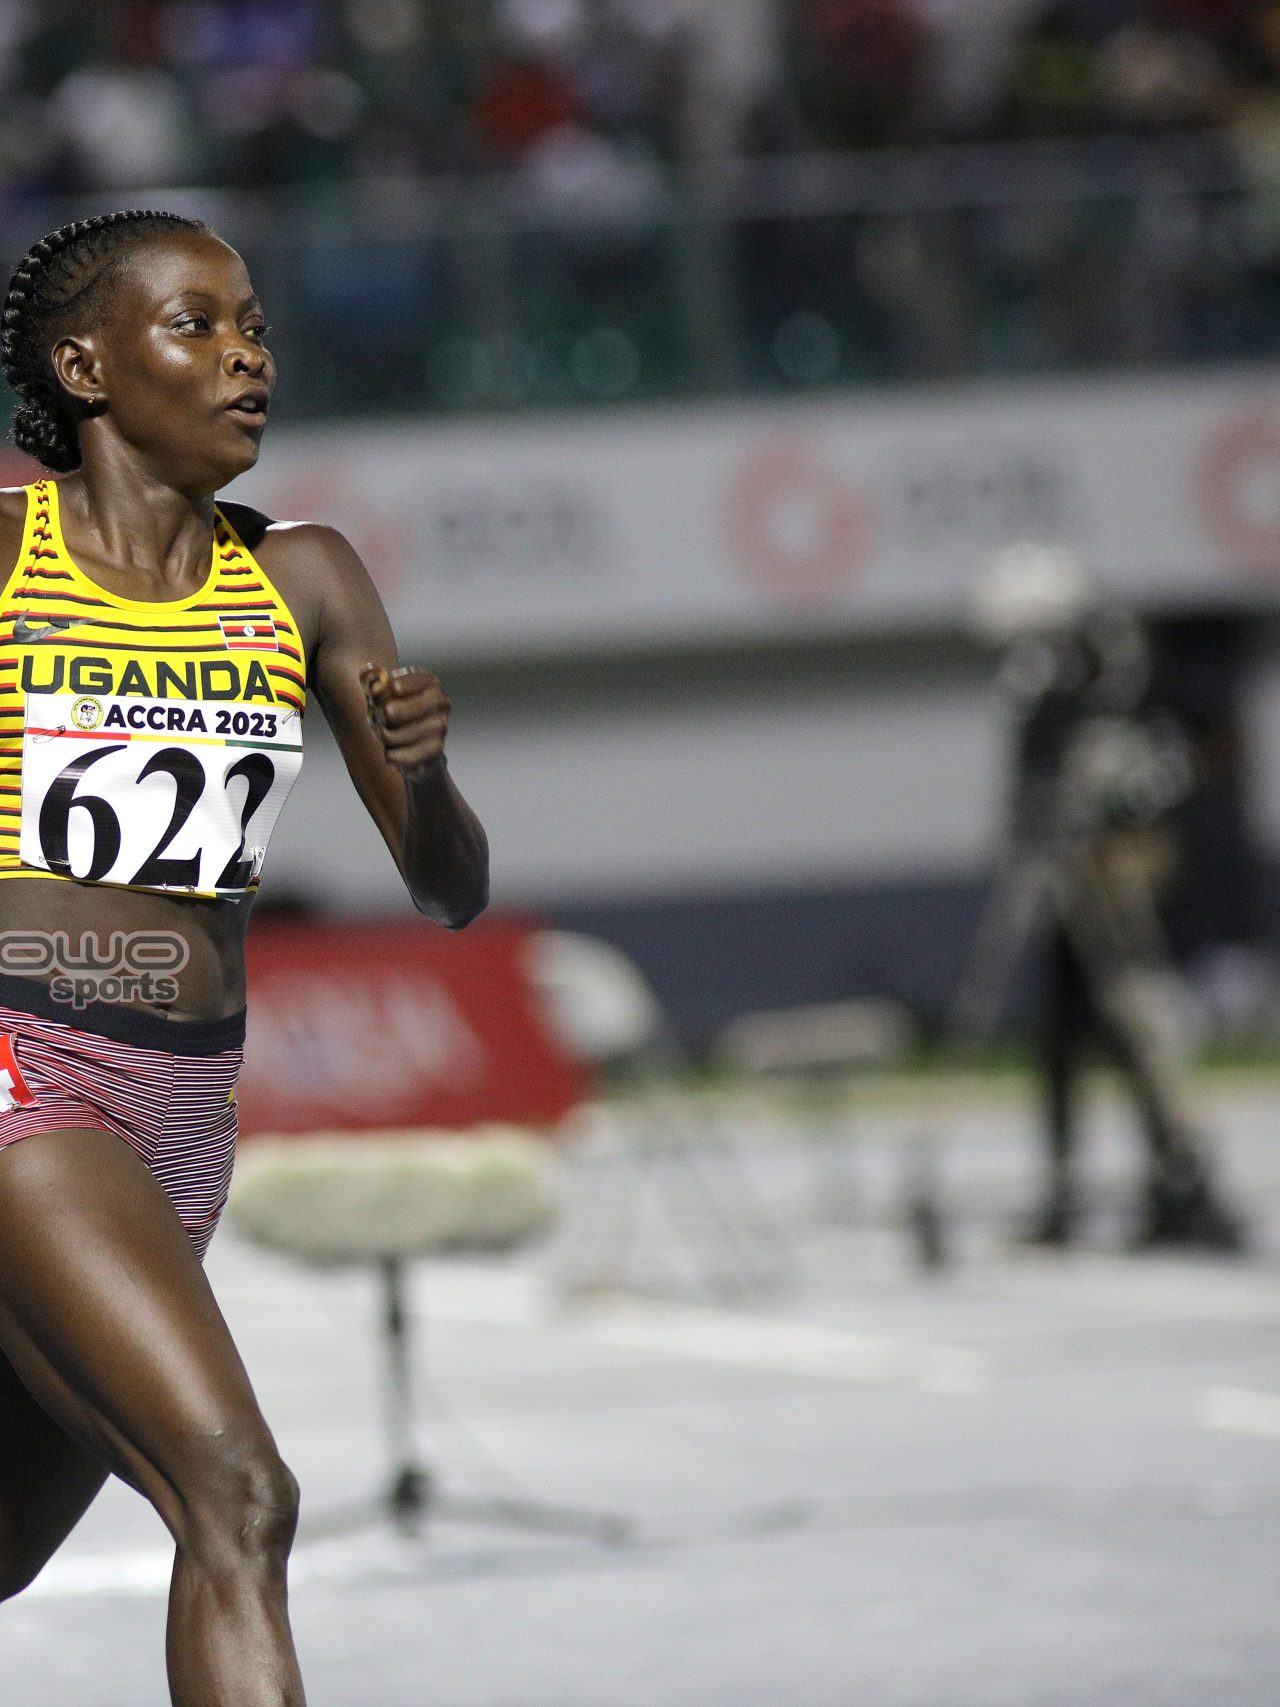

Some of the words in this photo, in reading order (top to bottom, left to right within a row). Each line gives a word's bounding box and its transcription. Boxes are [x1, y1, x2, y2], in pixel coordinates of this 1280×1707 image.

[21, 655, 275, 702] UGANDA
[104, 704, 208, 732] ACCRA
[215, 710, 277, 737] 2023
[38, 744, 276, 889] 622
